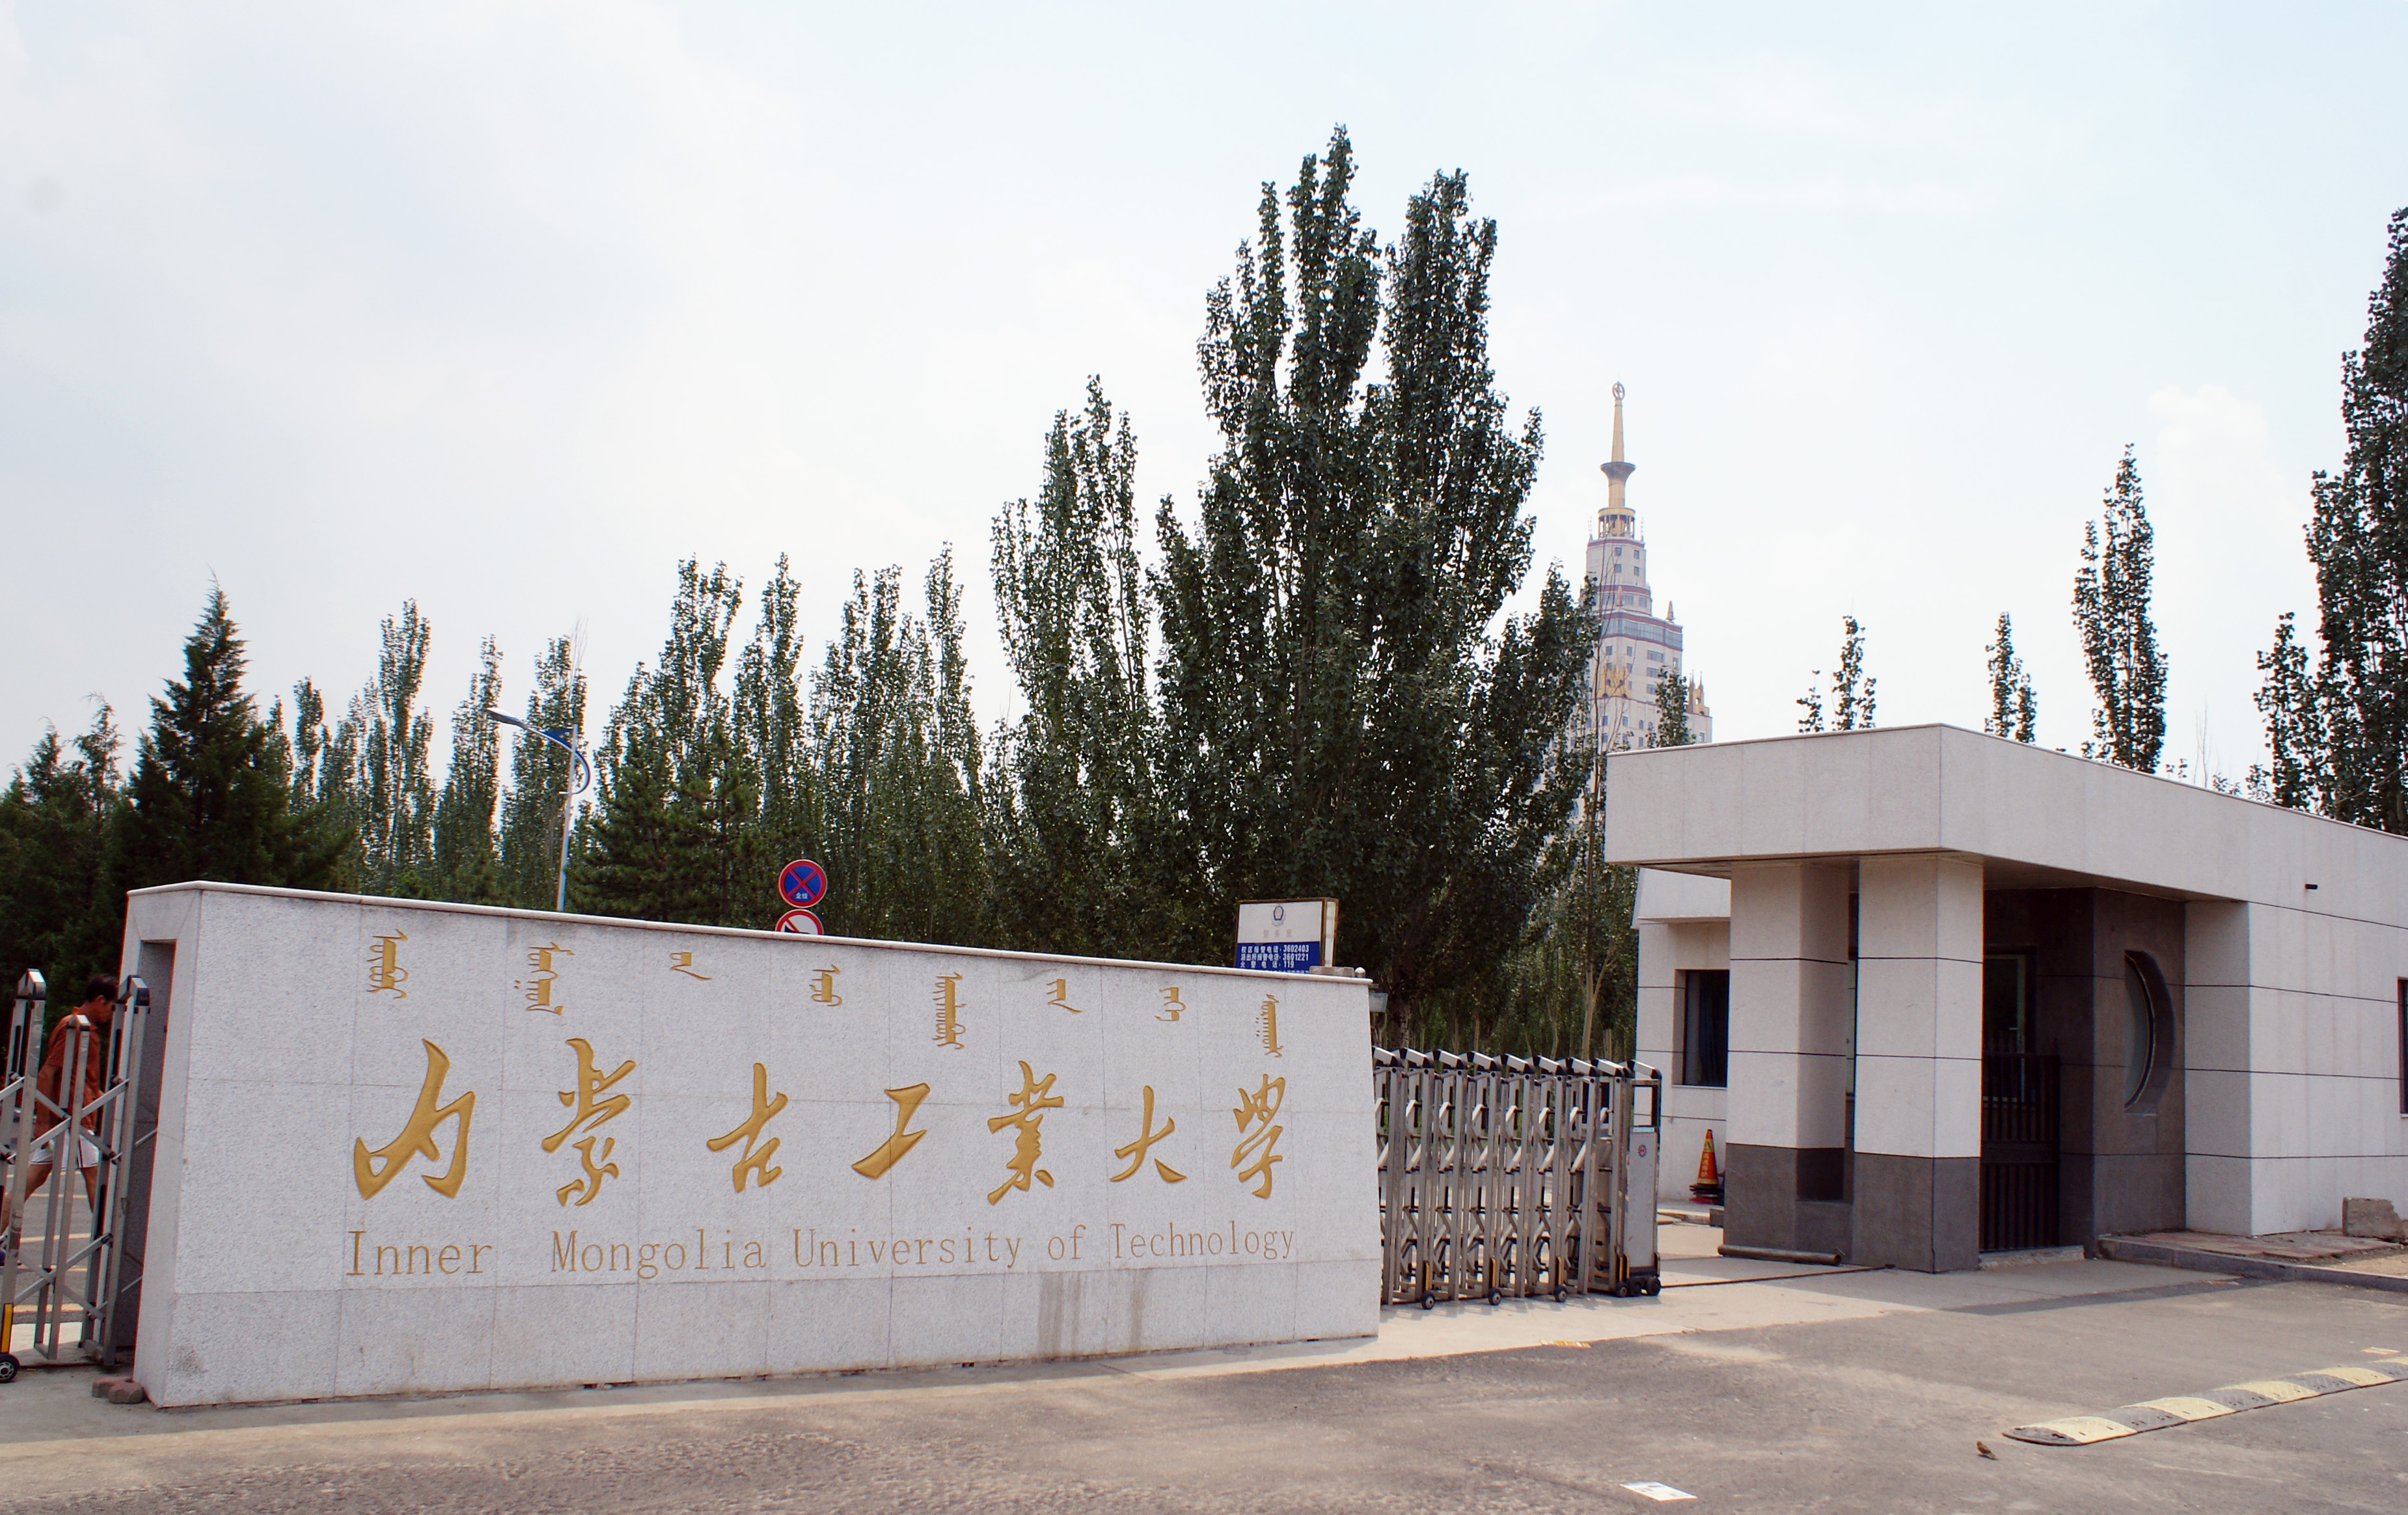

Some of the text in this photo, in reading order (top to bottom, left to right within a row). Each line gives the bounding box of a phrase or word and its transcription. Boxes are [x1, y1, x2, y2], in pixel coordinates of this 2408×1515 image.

[346, 1220, 1294, 1279] Inner Mongolia University of Technology
